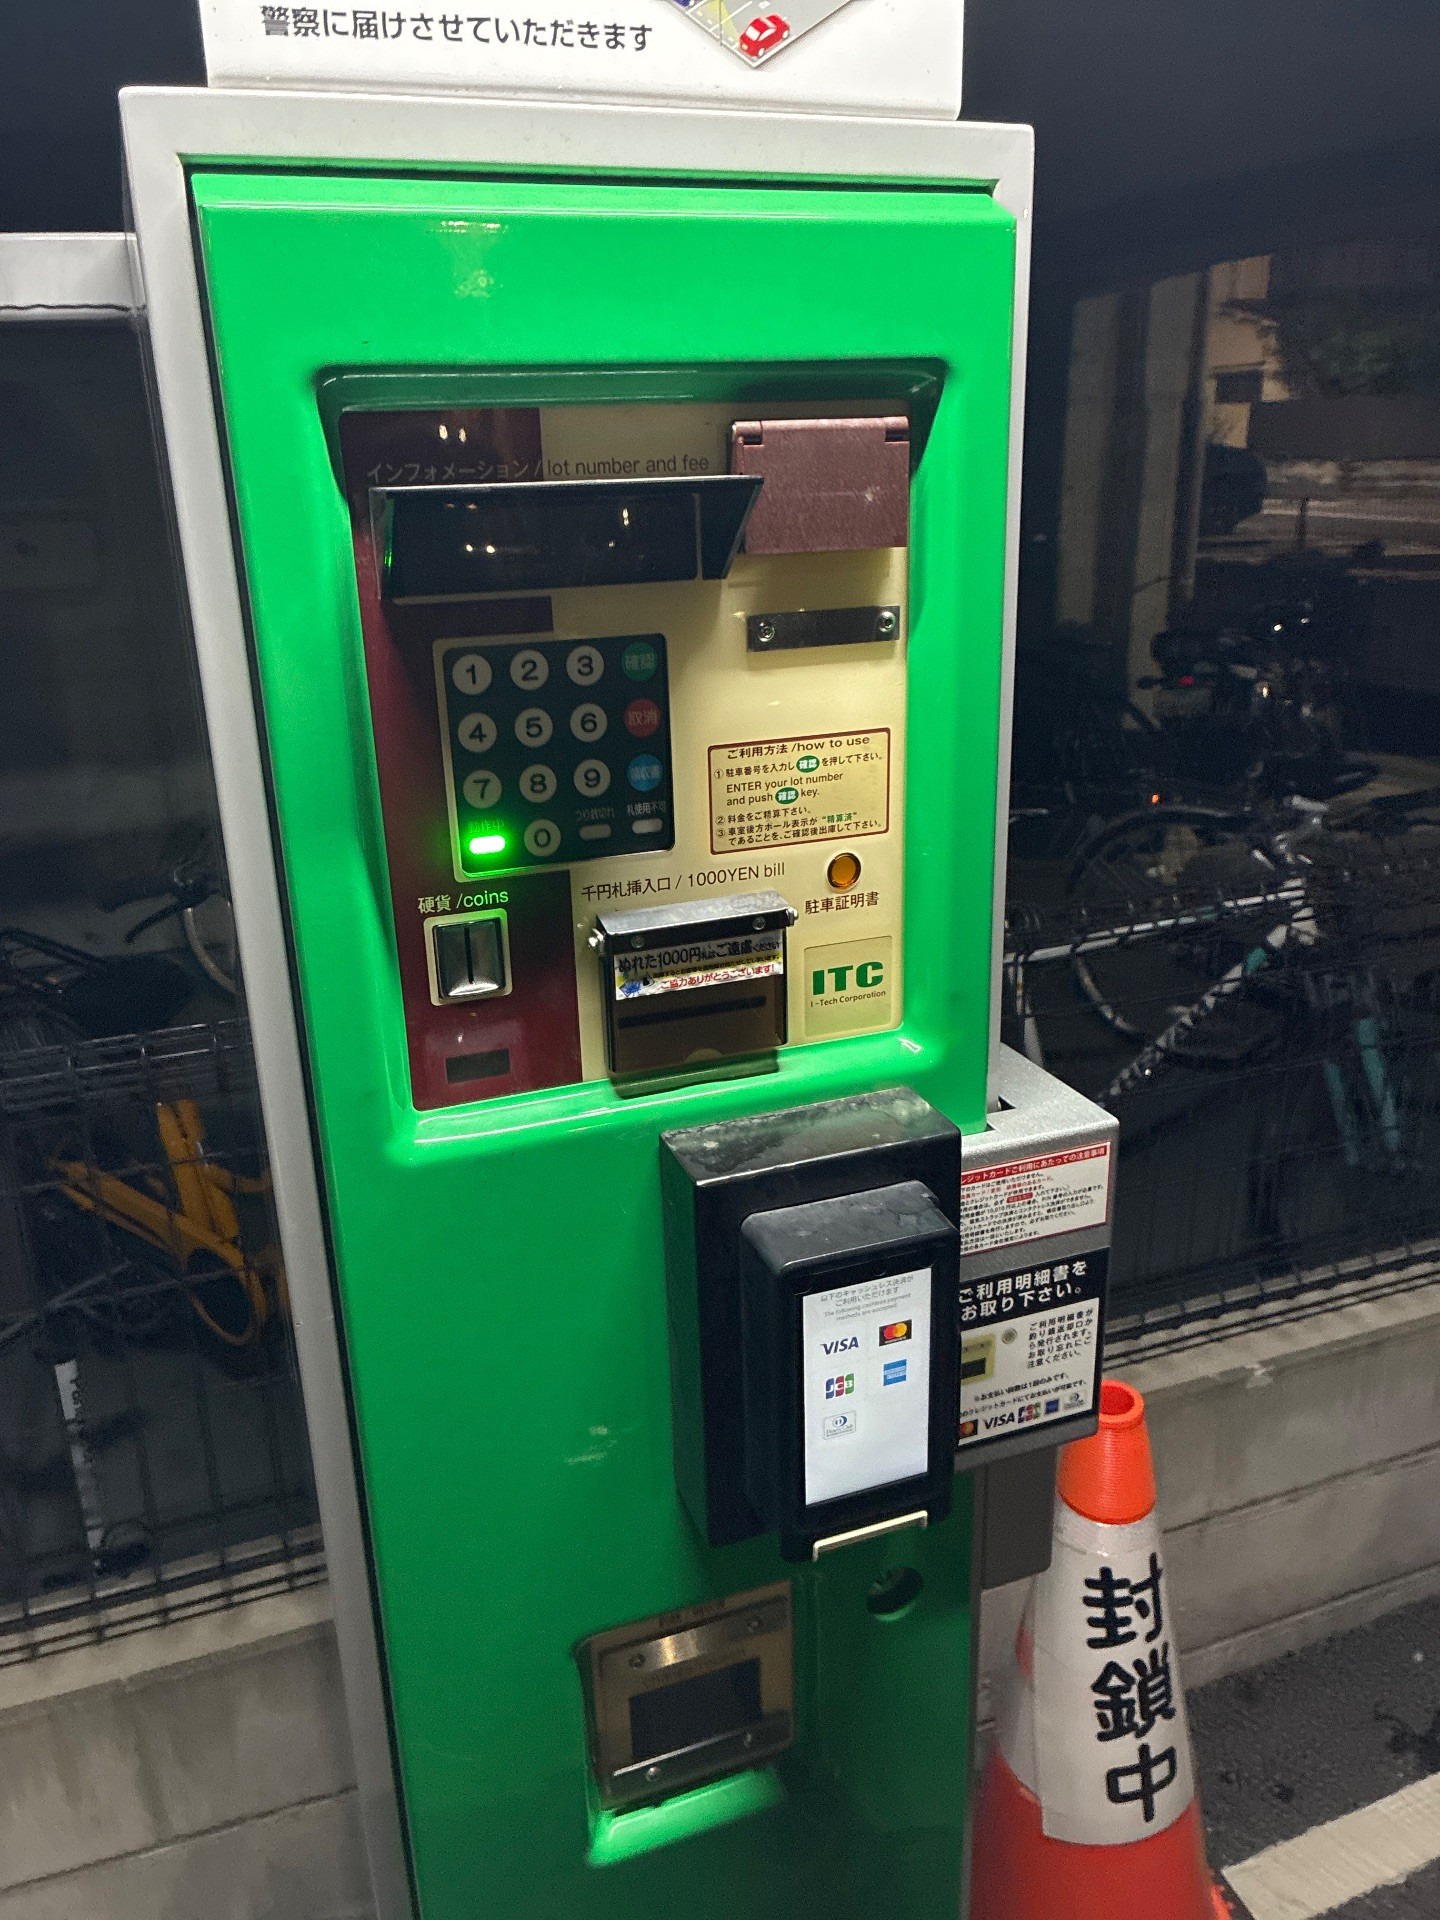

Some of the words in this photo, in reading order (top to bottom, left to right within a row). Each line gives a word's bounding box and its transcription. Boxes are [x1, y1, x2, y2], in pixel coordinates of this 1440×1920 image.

[261, 5, 653, 52] 警察に届けさせていただきます
[366, 460, 530, 484] インフォメーション
[547, 459, 569, 476] lot
[576, 458, 638, 475] number
[646, 456, 676, 472] and
[682, 454, 709, 471] fee
[465, 664, 477, 685] 1
[521, 659, 539, 682] 2
[577, 655, 594, 676] 3
[468, 723, 487, 743] 4
[525, 716, 543, 738] 5
[580, 712, 597, 733] 6
[727, 744, 788, 760] ご利用方法
[830, 738, 843, 748] to
[846, 736, 870, 746] use
[725, 762, 795, 777] 駐車番号を入力し
[821, 751, 882, 768] を押して下さい。
[473, 778, 490, 800] 7
[530, 773, 547, 794] 8
[583, 768, 601, 788] 9
[726, 781, 762, 794] ENTER
[765, 778, 787, 791] your
[790, 776, 803, 786] lot
[806, 773, 844, 784] number
[726, 794, 746, 806] and
[748, 791, 773, 807] push
[801, 788, 820, 800] key.
[727, 805, 811, 824] 料金をご精算下さい。
[533, 828, 551, 848] 0
[581, 877, 672, 903] 千円札挿入口
[688, 866, 759, 888] 1000YEN
[763, 861, 786, 878] bill
[417, 894, 451, 915] 硬貨
[804, 891, 880, 915] 駐車証明書
[812, 961, 884, 996] ITC
[839, 990, 887, 1004] Corporation
[958, 1261, 1087, 1304] ご利用明細書を
[961, 1283, 1082, 1321] お取り下さい。
[820, 1336, 859, 1355] VISA
[826, 1375, 854, 1397] JCB
[983, 1412, 1015, 1430] VISA
[1082, 1552, 1178, 1823] 封鎖中
